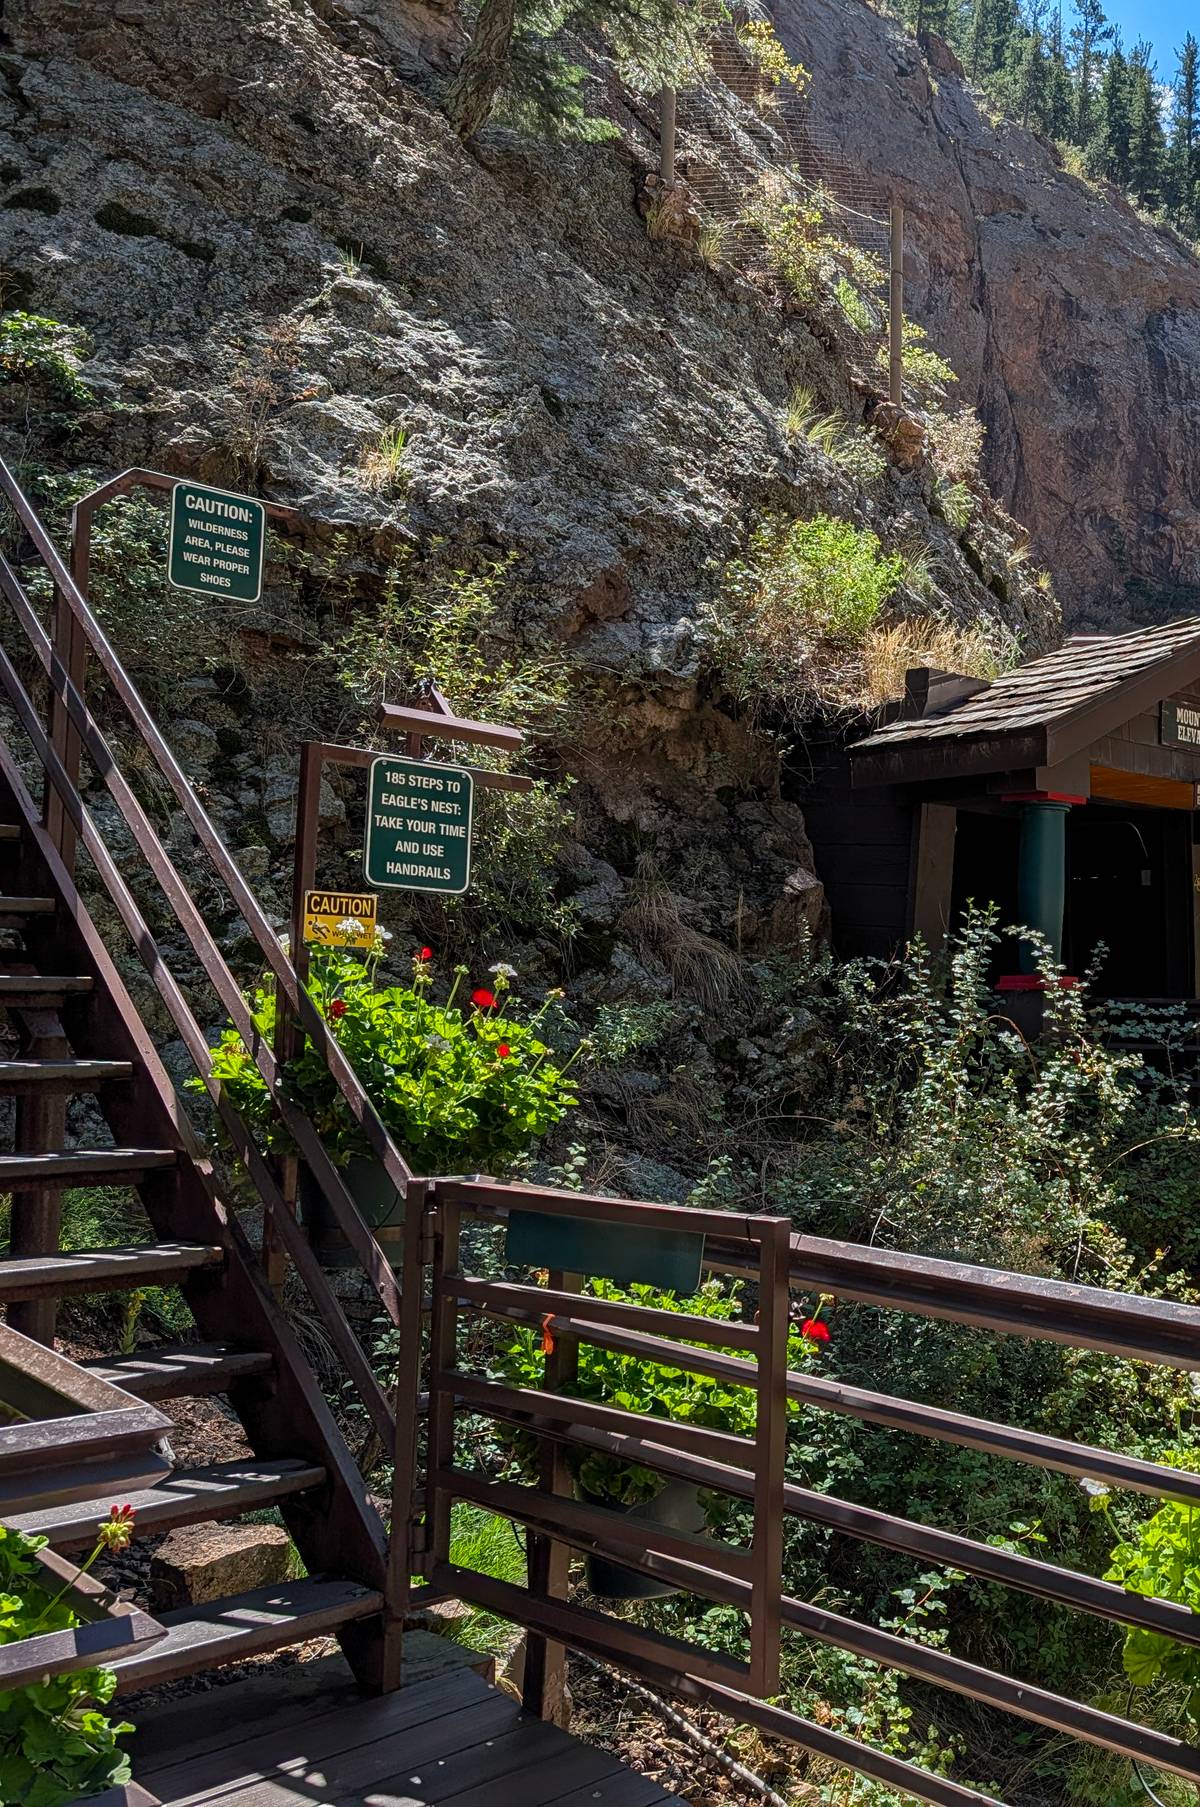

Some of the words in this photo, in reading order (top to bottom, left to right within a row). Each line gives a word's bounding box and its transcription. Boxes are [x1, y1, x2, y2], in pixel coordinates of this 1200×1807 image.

[185, 494, 253, 524] CAUTION:
[188, 518, 248, 541] WILDERNESS
[184, 535, 213, 552] AREA,
[215, 541, 250, 558] PLEASE
[183, 551, 211, 566] WEAR
[213, 557, 250, 575] PROPER
[200, 572, 231, 587] SHOES
[384, 771, 405, 785] 185
[408, 774, 443, 792] STEPS
[447, 781, 461, 793] TO
[381, 793, 428, 811] EAGLE'S
[431, 800, 462, 816] NEST:
[374, 814, 403, 829] TAKE
[406, 819, 436, 834] YOUR
[439, 823, 466, 838] TIME
[395, 840, 420, 854] AND
[422, 844, 445, 857] USE
[386, 861, 451, 880] HANDRAILS
[310, 895, 371, 916] CAUTION
[356, 931, 372, 940] WET
